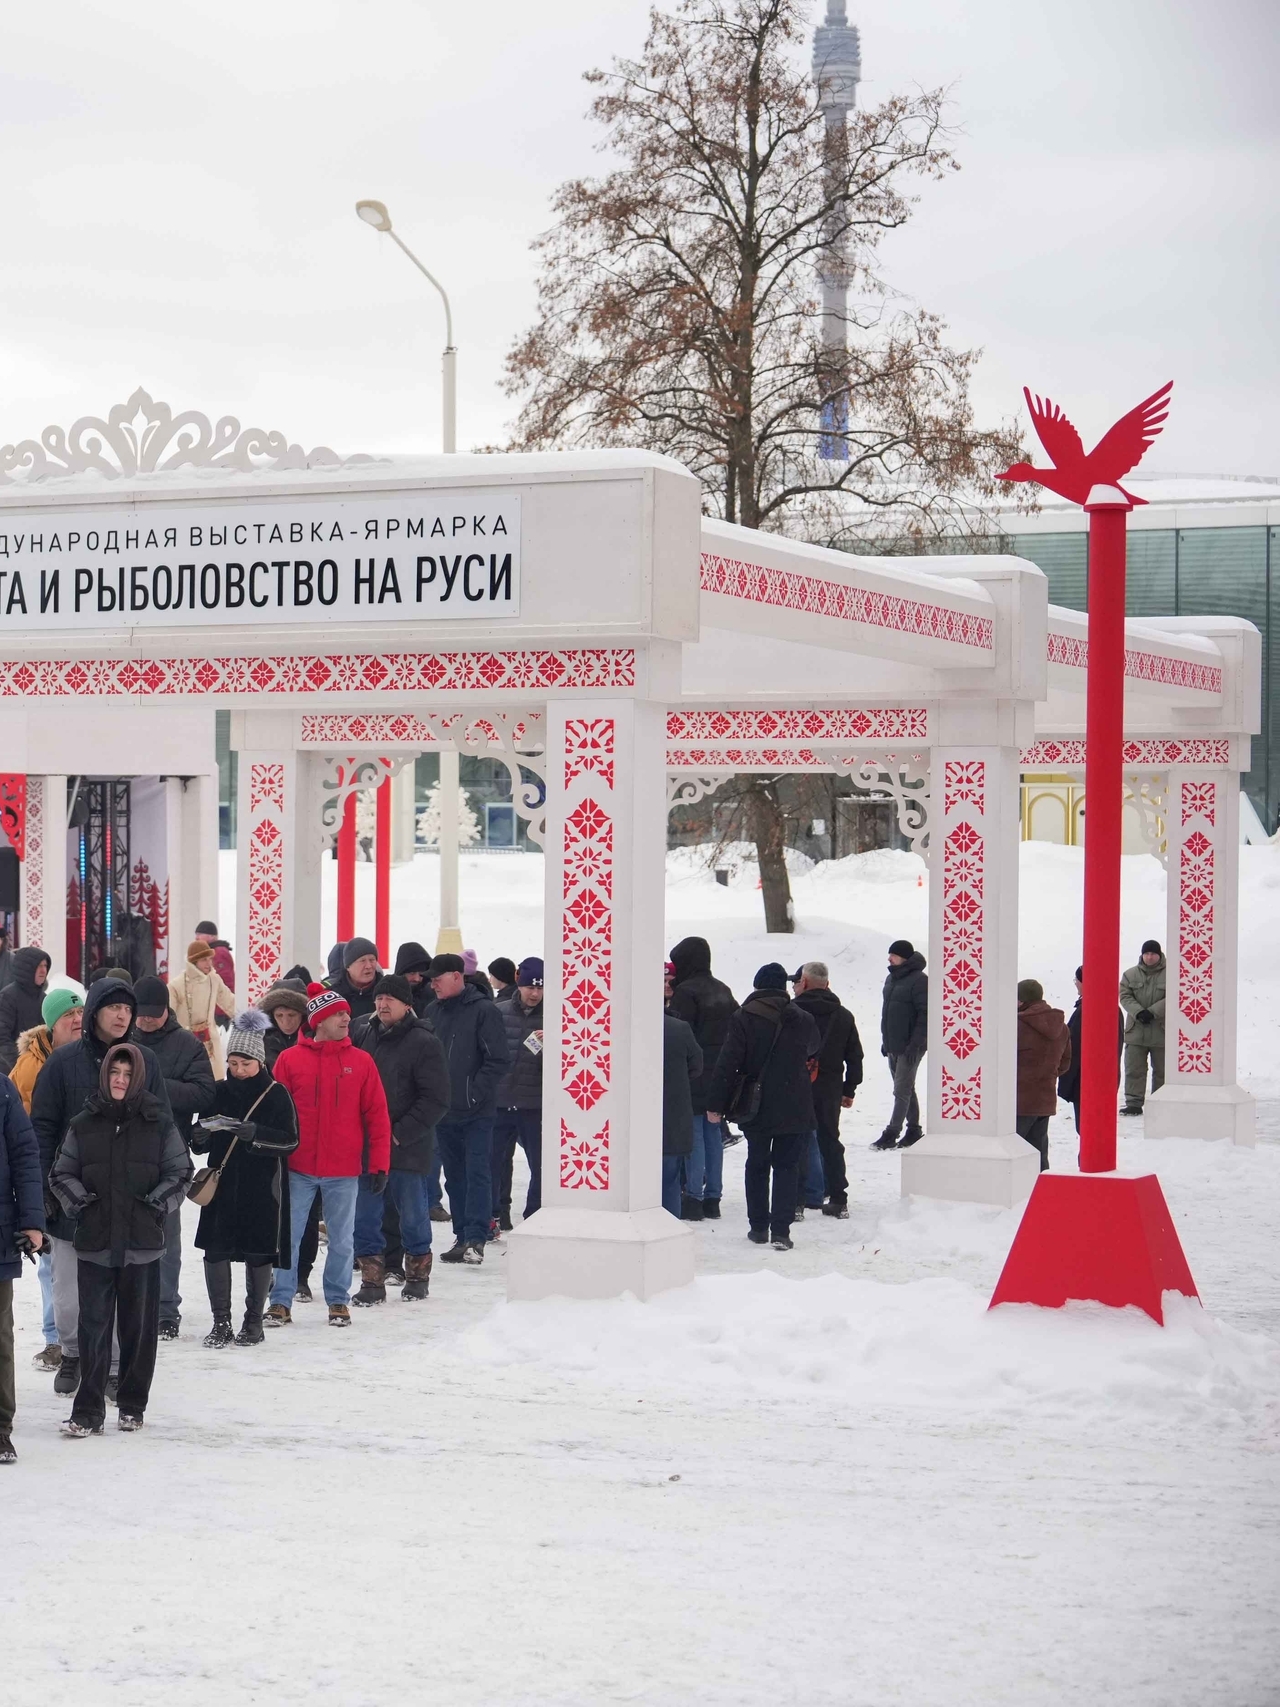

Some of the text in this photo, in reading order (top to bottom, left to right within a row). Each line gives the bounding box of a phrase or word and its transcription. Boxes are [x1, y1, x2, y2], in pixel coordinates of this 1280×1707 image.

[190, 515, 507, 546] ВЫСТАВКА-ЯРМАРКА
[40, 569, 59, 613] И
[74, 558, 339, 613] РЫБОЛОВСТВО
[354, 557, 402, 604] НА
[416, 553, 512, 602] РУСИ
